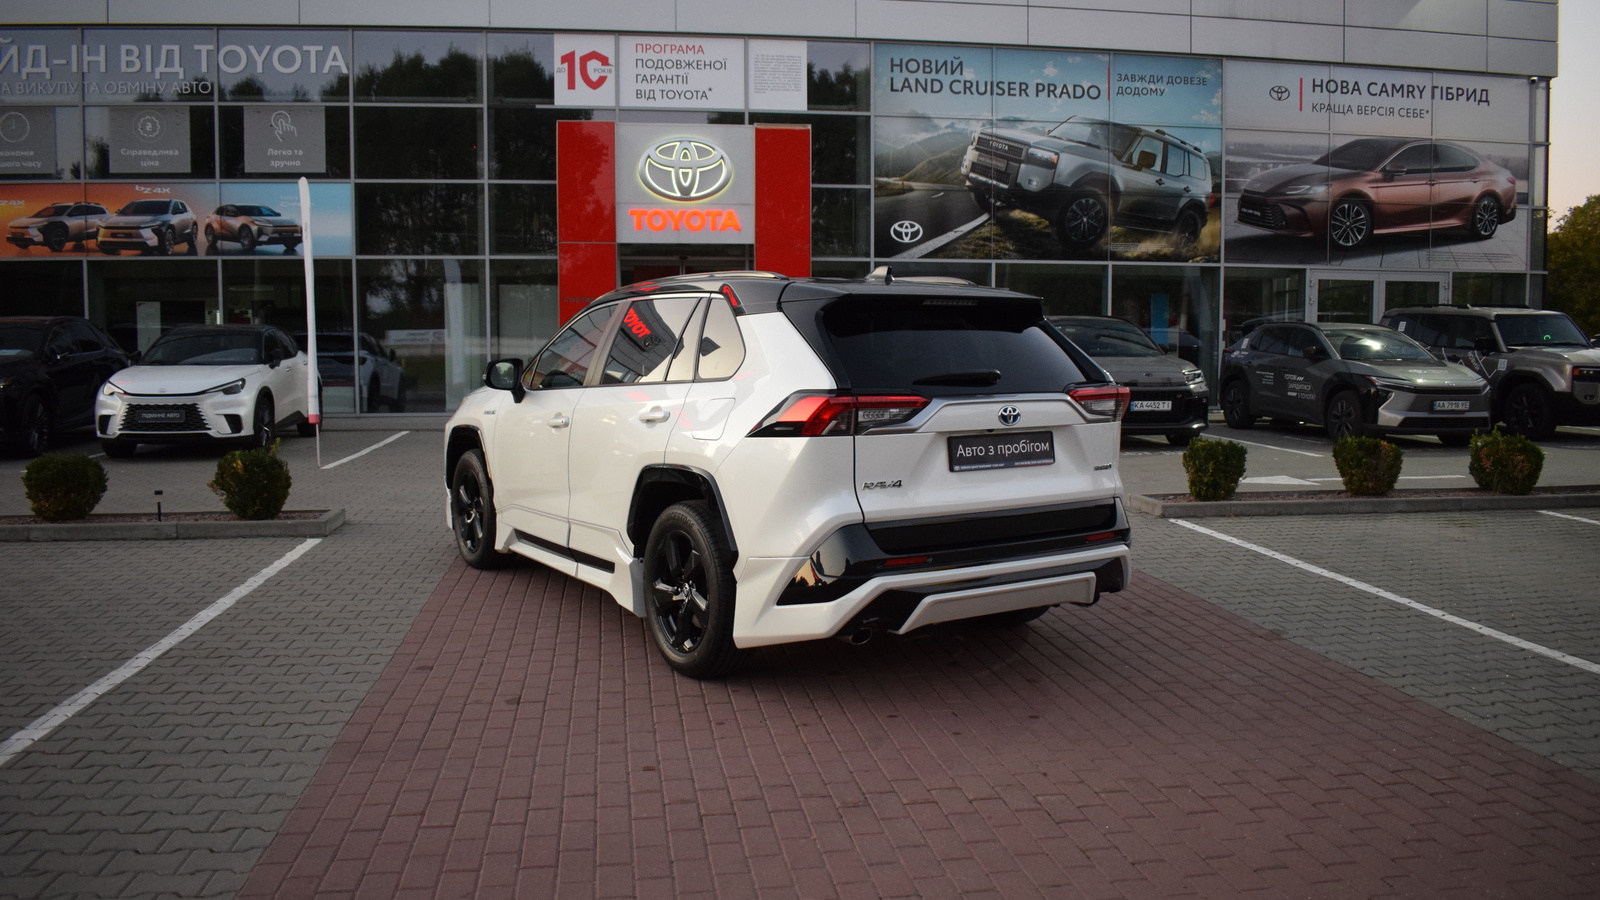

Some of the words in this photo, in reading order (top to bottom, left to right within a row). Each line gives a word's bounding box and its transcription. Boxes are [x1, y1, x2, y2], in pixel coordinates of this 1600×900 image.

[636, 43, 705, 55] ПРОГРАМА
[121, 44, 184, 79] ВІД
[194, 45, 348, 74] TOYOTA
[636, 58, 727, 71] ПОДОВЖЕНОЇ
[890, 56, 964, 76] НОВИЙ
[636, 73, 689, 85] ГАРАНТІЇ
[1116, 73, 1164, 87] ЗАВЖДИ
[1166, 75, 1207, 87] ДОВЕЗЕ
[16, 82, 79, 94] ВИКУПУ
[83, 82, 101, 94] ТА
[104, 81, 167, 94] ОБМІНУ
[171, 81, 212, 94] АВТО
[890, 77, 943, 93] LAND
[949, 79, 1030, 98] CRUISER
[1035, 83, 1101, 100] PRADO
[1116, 86, 1166, 98] ДОДОМУ
[1312, 79, 1362, 95] НОВА
[1366, 81, 1427, 100] CAMRY
[1431, 86, 1490, 106] ГІБРИД
[636, 90, 656, 101] ВІД
[1311, 103, 1354, 116] КРАЩА
[1357, 105, 1395, 117] ВЕРСІЯ
[121, 148, 179, 158] Справедлива
[267, 148, 290, 156] Легко
[140, 159, 160, 168] ціна
[270, 159, 301, 168] зручно
[629, 209, 741, 232] TOYOTA
[957, 444, 985, 458] Авто
[988, 446, 995, 456] з
[997, 440, 1050, 458] пробігом
[862, 479, 902, 490] RAV4
